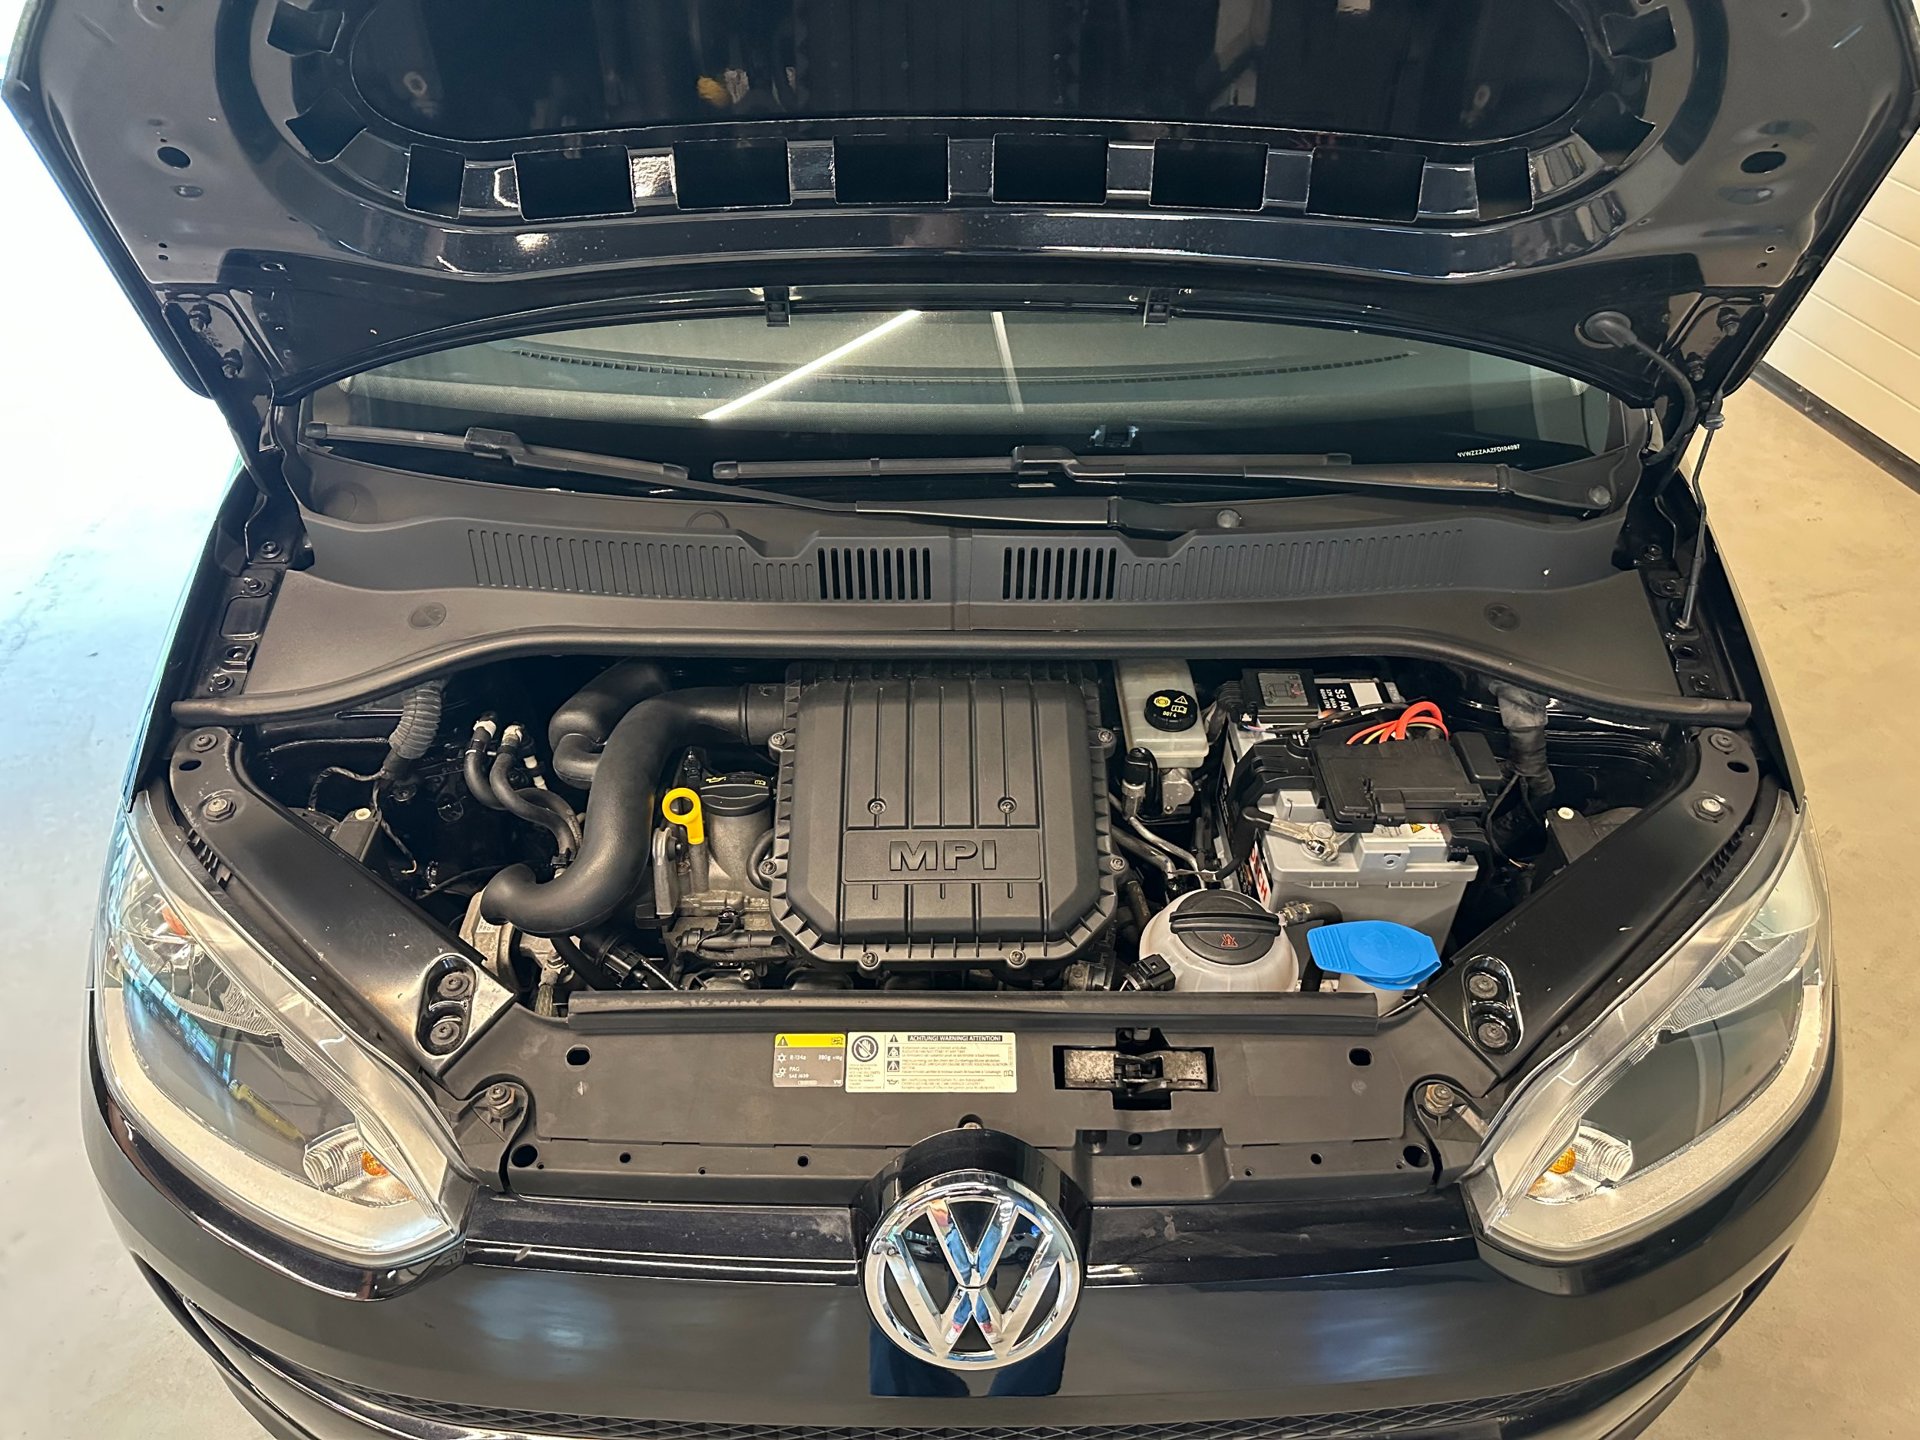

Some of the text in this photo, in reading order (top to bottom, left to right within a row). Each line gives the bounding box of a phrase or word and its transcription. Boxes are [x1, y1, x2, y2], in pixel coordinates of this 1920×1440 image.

[1334, 688, 1347, 700] S5
[889, 840, 997, 871] MPI
[872, 1180, 1074, 1366] VW
